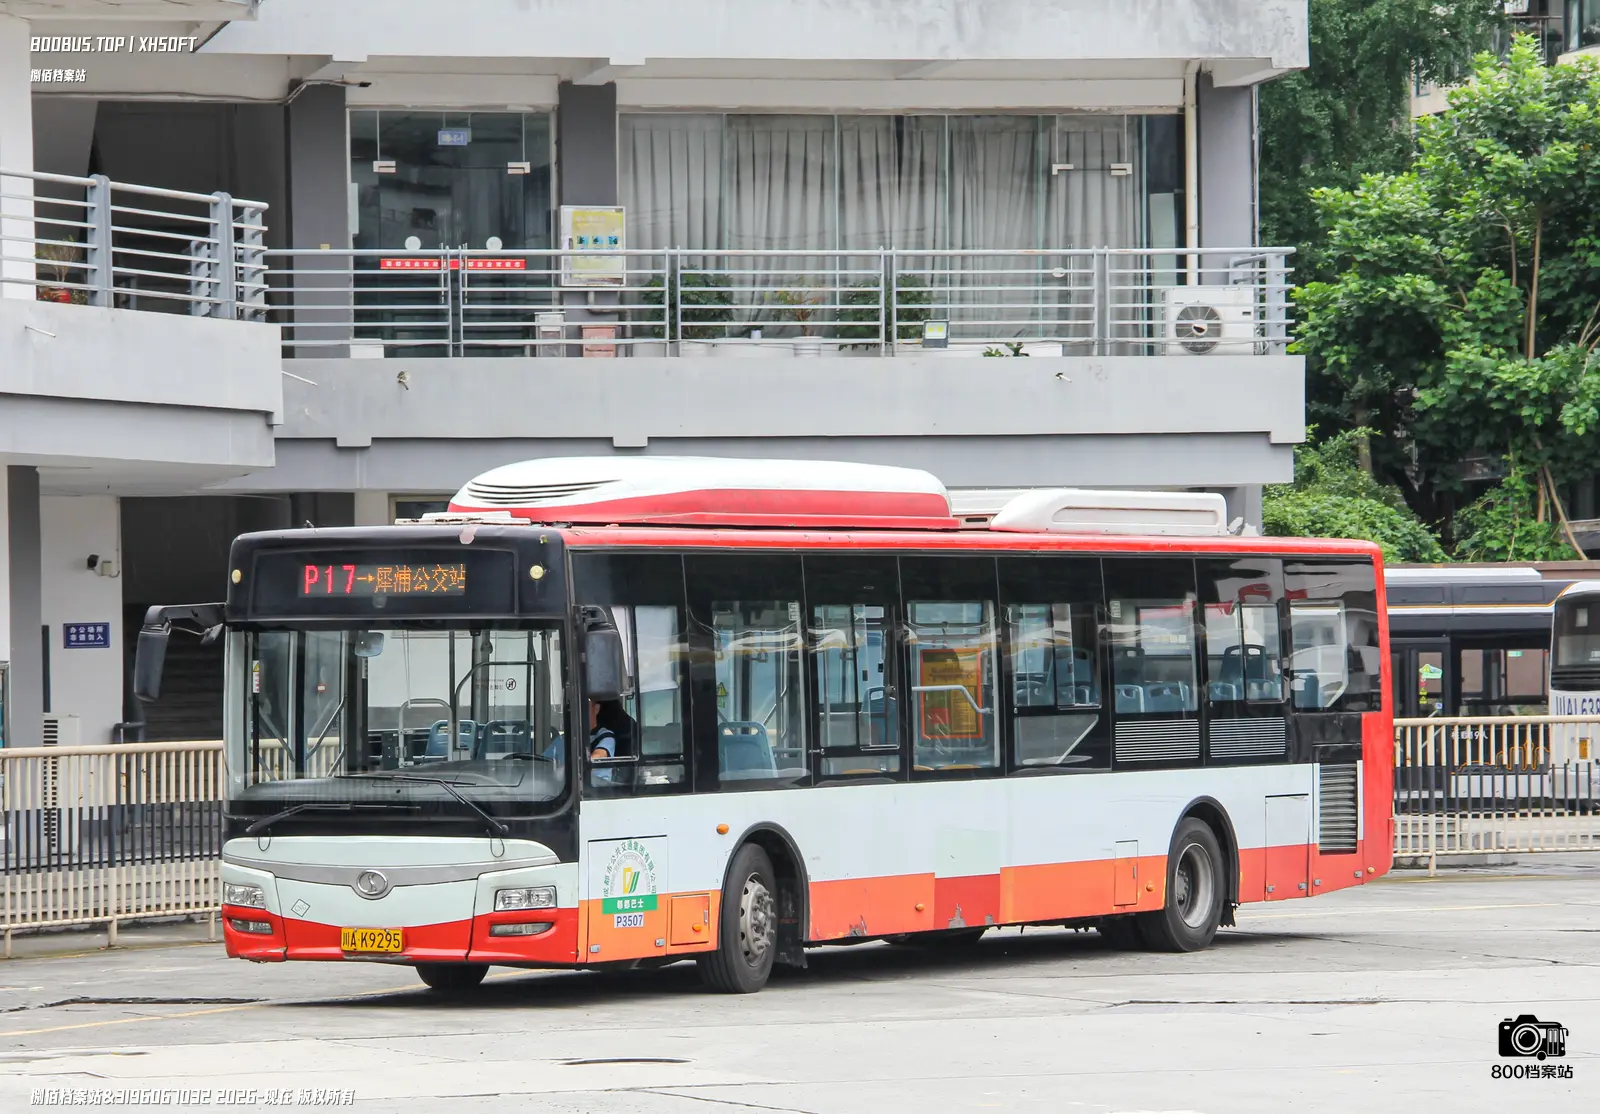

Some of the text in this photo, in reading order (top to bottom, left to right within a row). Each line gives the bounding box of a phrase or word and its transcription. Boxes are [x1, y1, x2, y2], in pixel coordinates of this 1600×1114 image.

[304, 564, 466, 594] P17 犀浦公交站
[70, 626, 104, 634] 办公场所
[603, 840, 657, 898] 成都市公共交通集团有限公司
[616, 914, 644, 928] P3507
